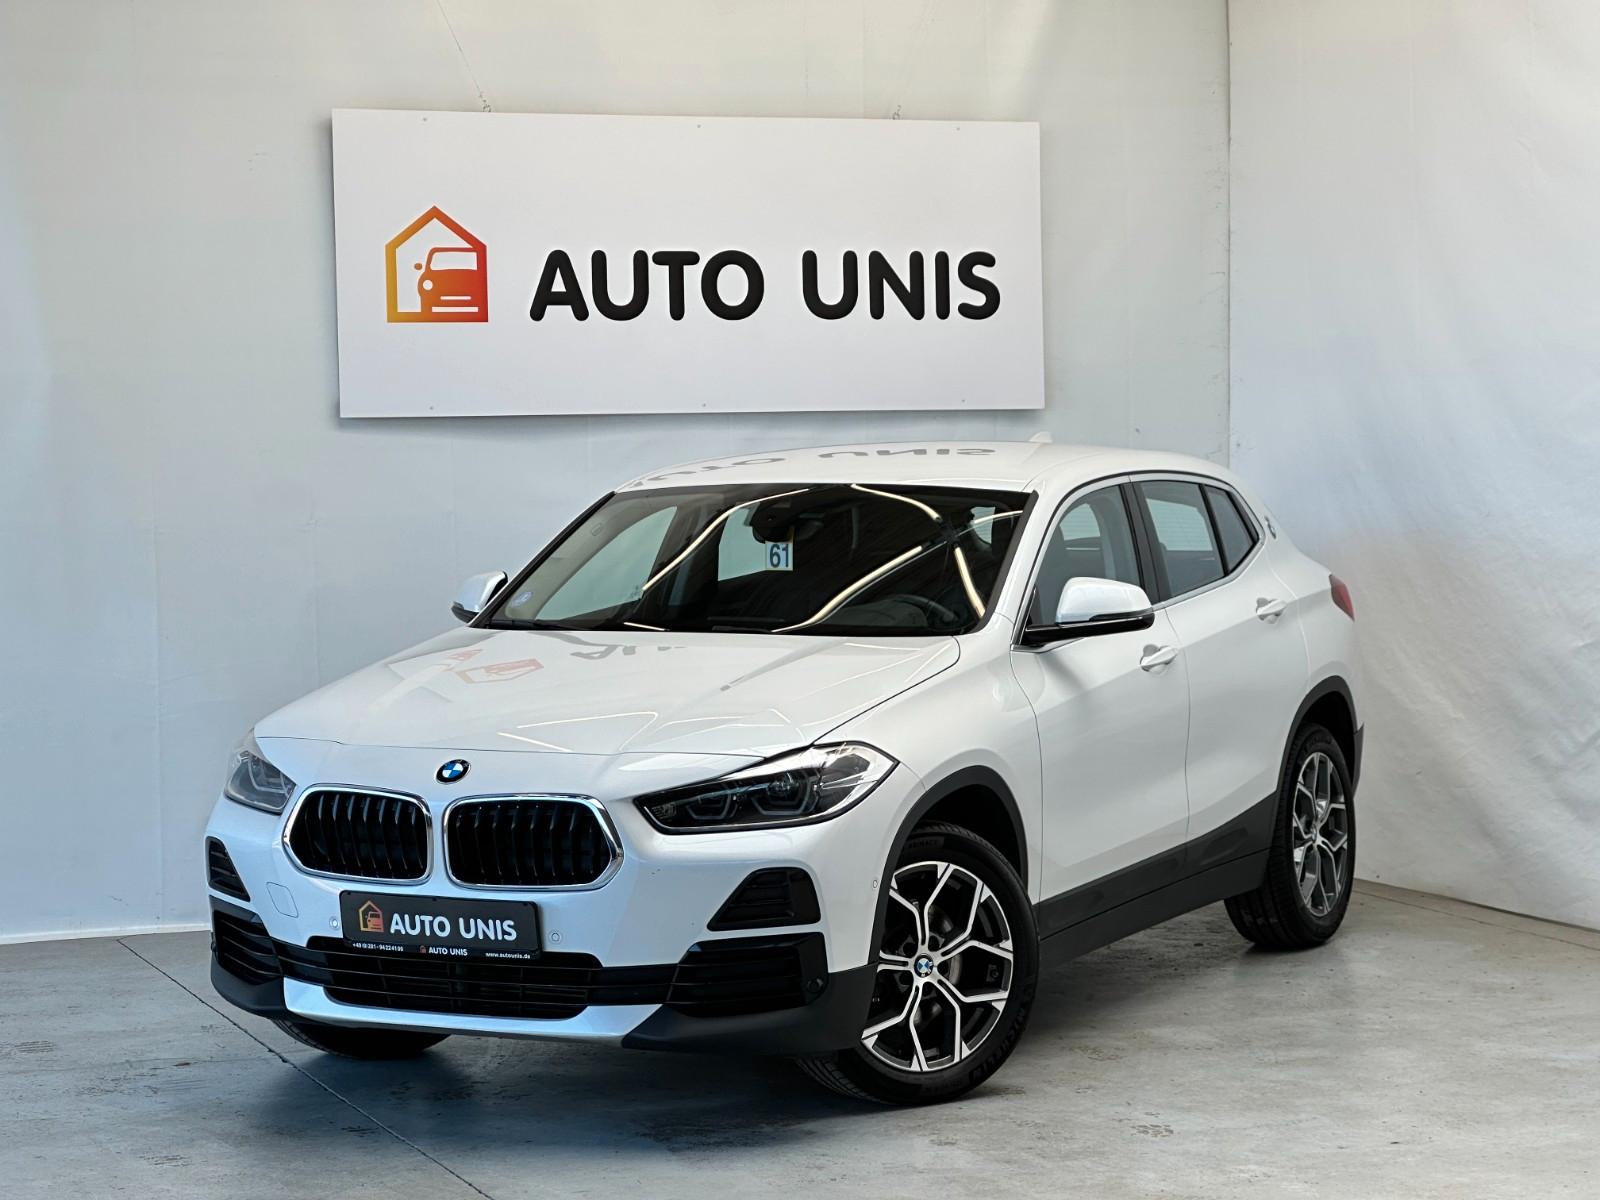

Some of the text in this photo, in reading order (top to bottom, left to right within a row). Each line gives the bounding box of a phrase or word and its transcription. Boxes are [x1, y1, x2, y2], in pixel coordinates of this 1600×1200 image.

[529, 249, 1001, 322] AUTO UNIS
[768, 541, 791, 569] 61
[390, 912, 518, 941] AUTO UNIS
[428, 946, 468, 956] AUTO UNIS
